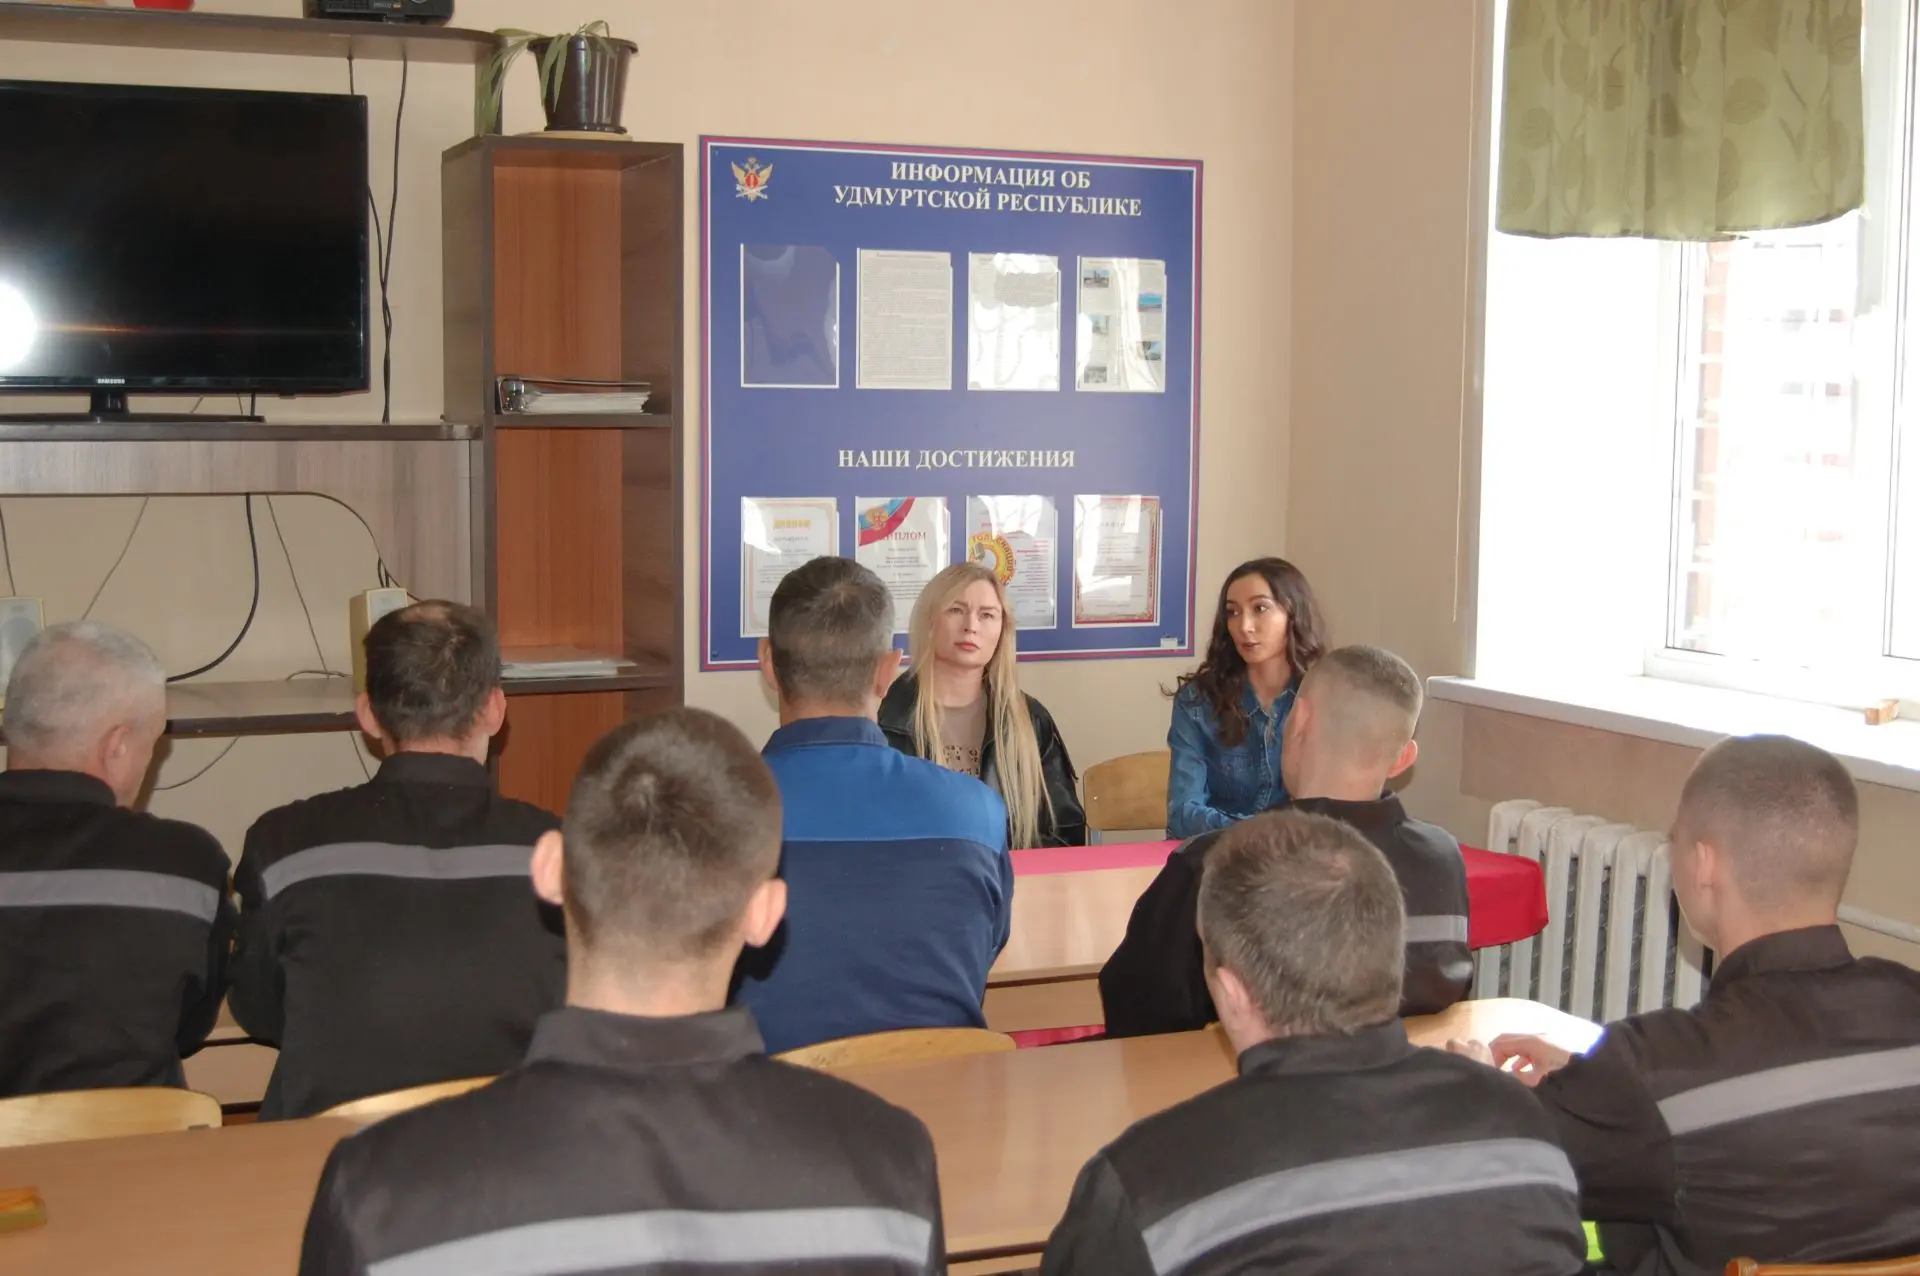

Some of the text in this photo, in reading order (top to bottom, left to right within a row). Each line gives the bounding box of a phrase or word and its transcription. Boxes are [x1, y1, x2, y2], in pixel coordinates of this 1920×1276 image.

[890, 161, 1091, 189] ИНФОРМАЦИЯ ОБ
[833, 185, 1143, 216] УДМУРТСКОЙ РЕСПУБЛИКЕ
[838, 449, 1076, 471] НАШИ ДОСТИЖЕНИЯ
